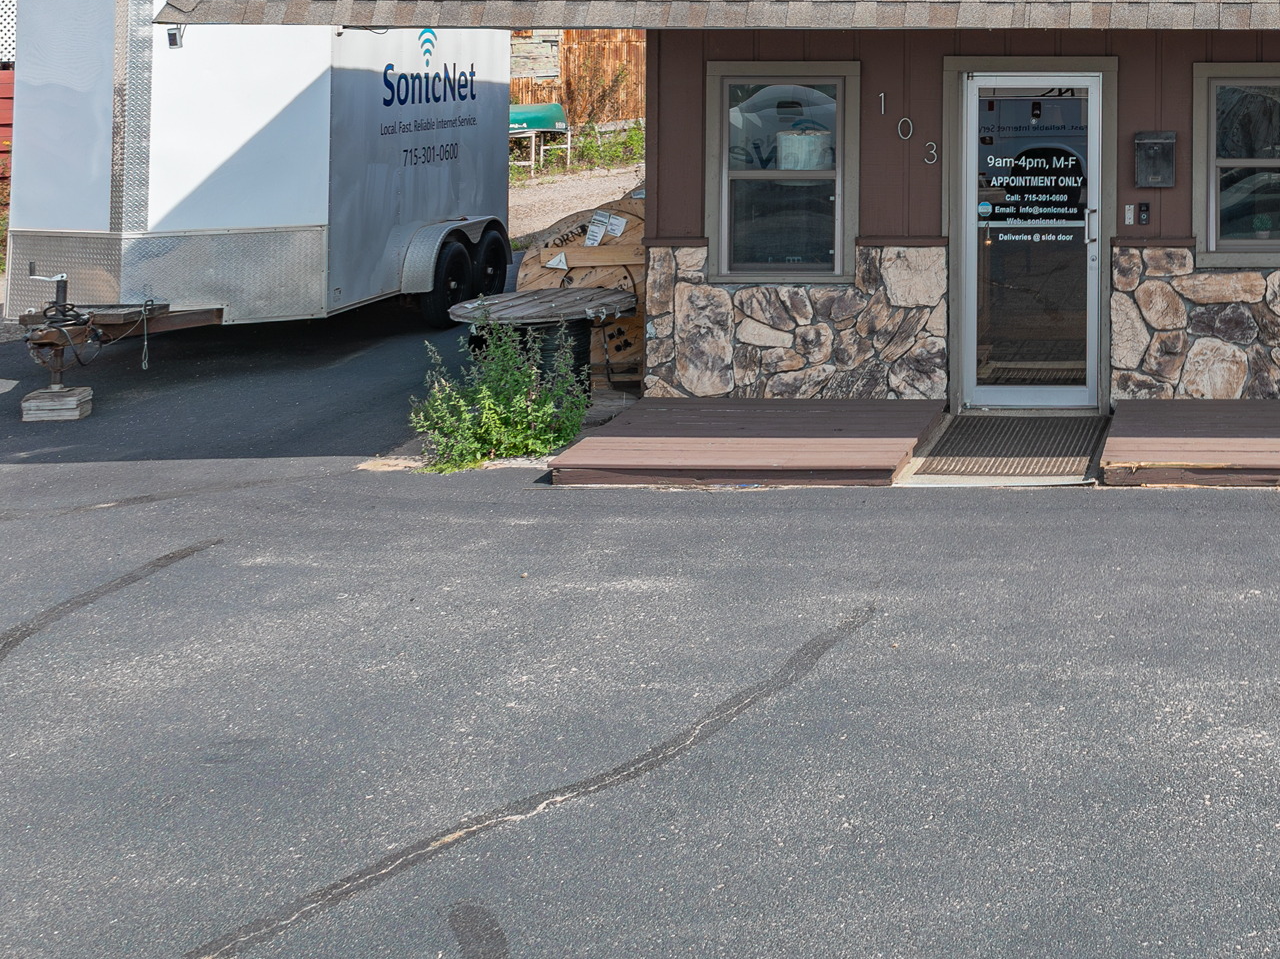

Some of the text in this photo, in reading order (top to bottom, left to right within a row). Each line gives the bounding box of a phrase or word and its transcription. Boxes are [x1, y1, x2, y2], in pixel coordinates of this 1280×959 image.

[382, 59, 477, 108] SonicNet
[380, 113, 478, 136] Local. Fast. Reliable Internet Service.
[402, 142, 459, 167] 715-301-0600
[986, 155, 1077, 170] 9am-4pm, M-F
[990, 176, 1084, 187] APPOINTMENT ONLY
[1005, 194, 1068, 202] Call: 715-301-0600
[994, 205, 1078, 215] Email: info@sonicnet.us
[1006, 217, 1067, 225] Web: sonicnet.us
[998, 233, 1032, 241] Deliveries
[1041, 233, 1056, 241] side
[1057, 233, 1074, 241] door
